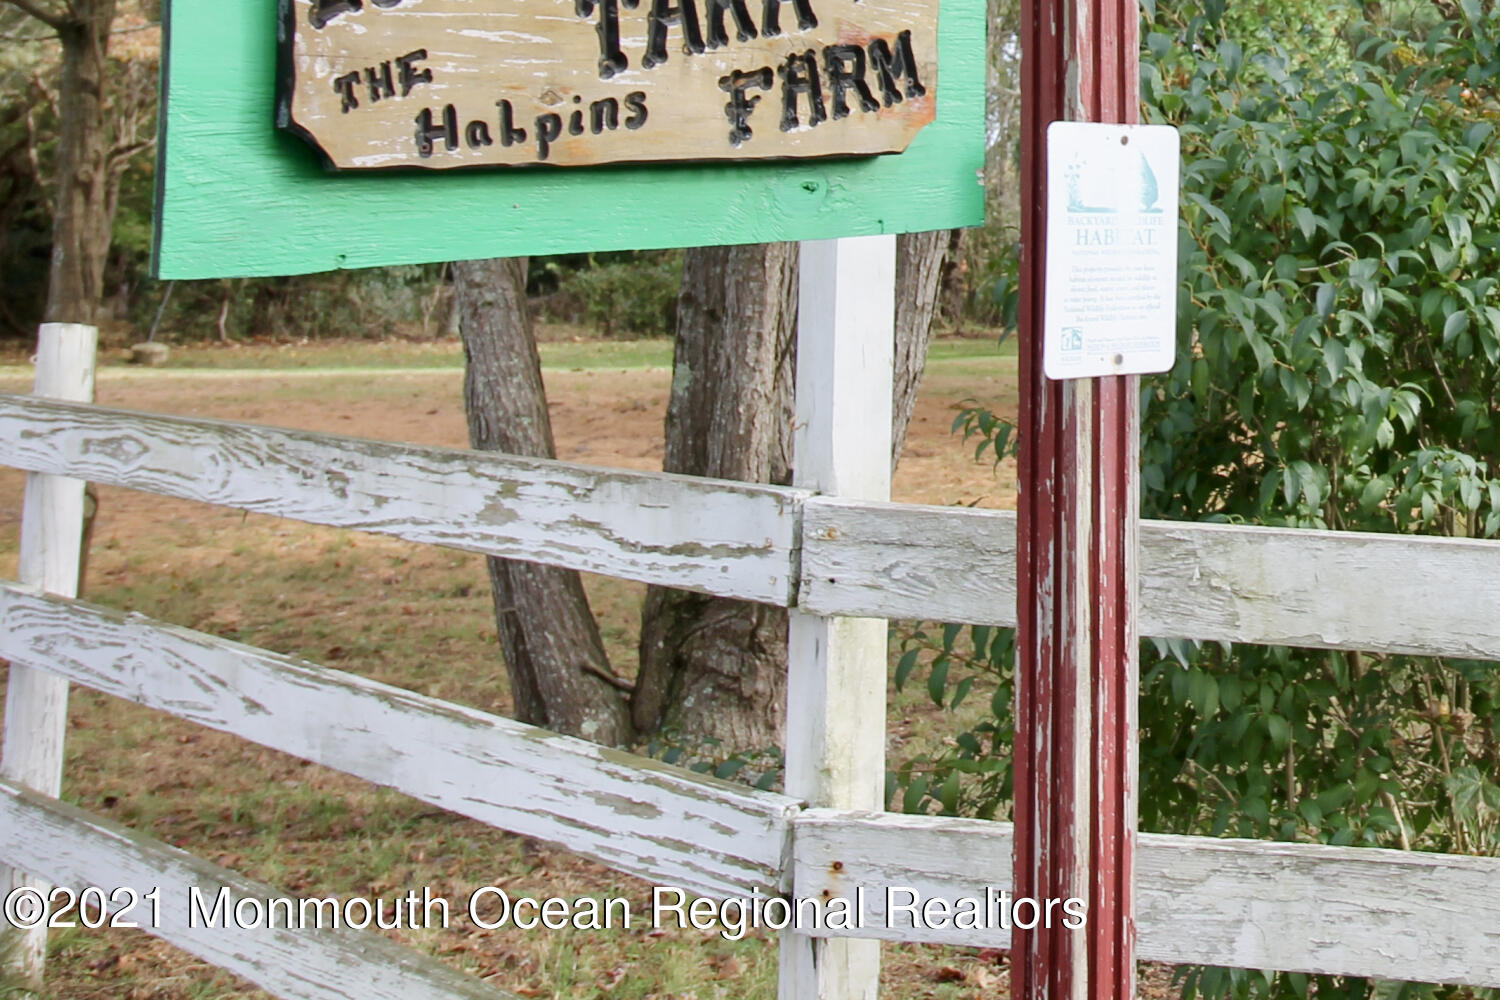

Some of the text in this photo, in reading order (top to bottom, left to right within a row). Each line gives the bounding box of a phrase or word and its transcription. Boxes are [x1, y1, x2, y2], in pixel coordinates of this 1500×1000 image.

[333, 47, 433, 113] THE
[718, 29, 926, 148] FARM
[414, 90, 648, 160] Halpins
